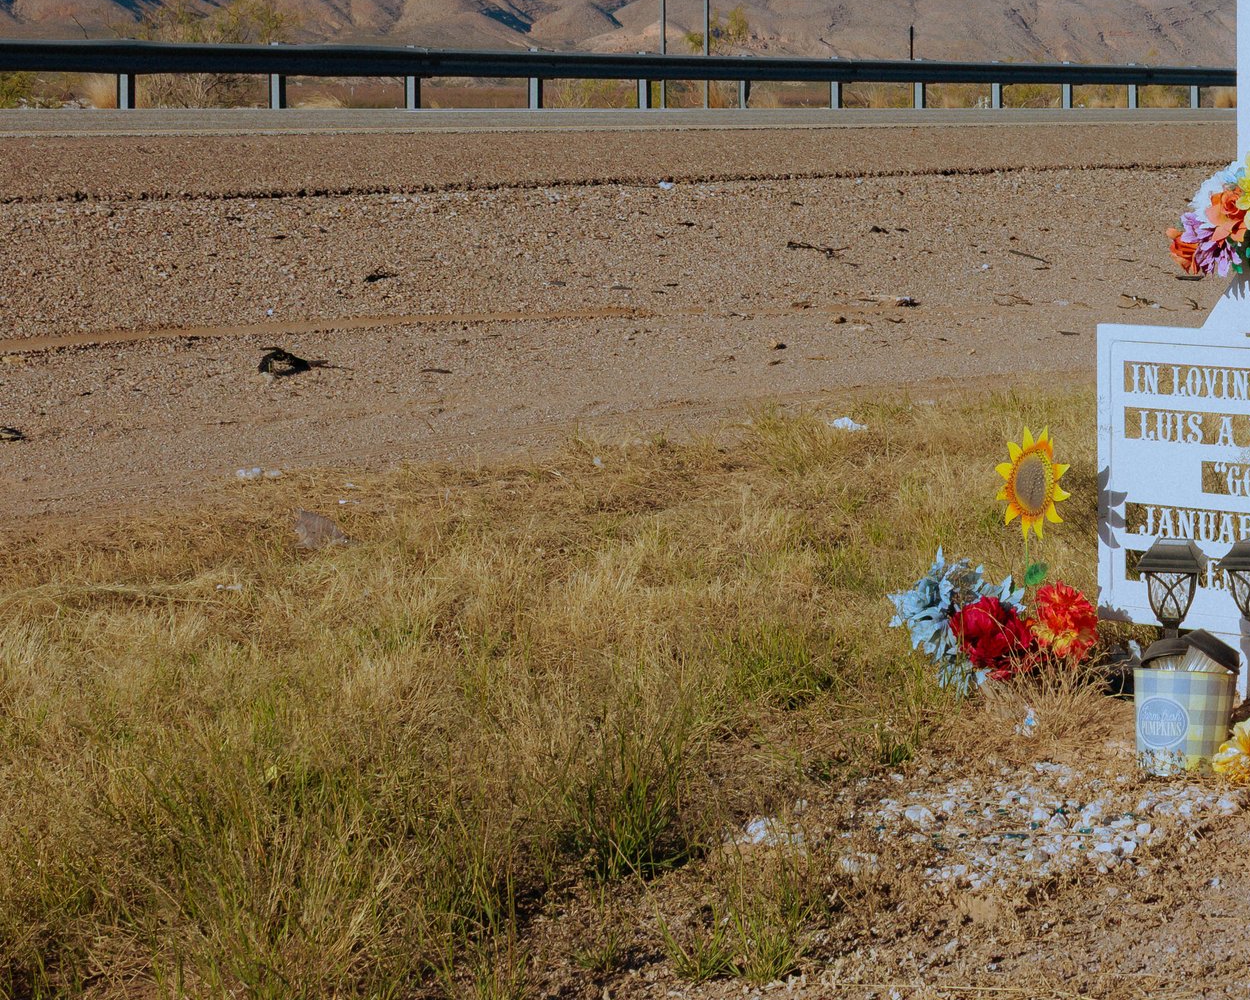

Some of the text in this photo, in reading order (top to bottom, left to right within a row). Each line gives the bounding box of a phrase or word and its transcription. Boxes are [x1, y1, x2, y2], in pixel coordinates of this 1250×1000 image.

[1131, 364, 1160, 395] IN
[1139, 410, 1204, 444] LUIS
[1216, 415, 1238, 446] A
[1141, 720, 1182, 737] PUMPKINS
